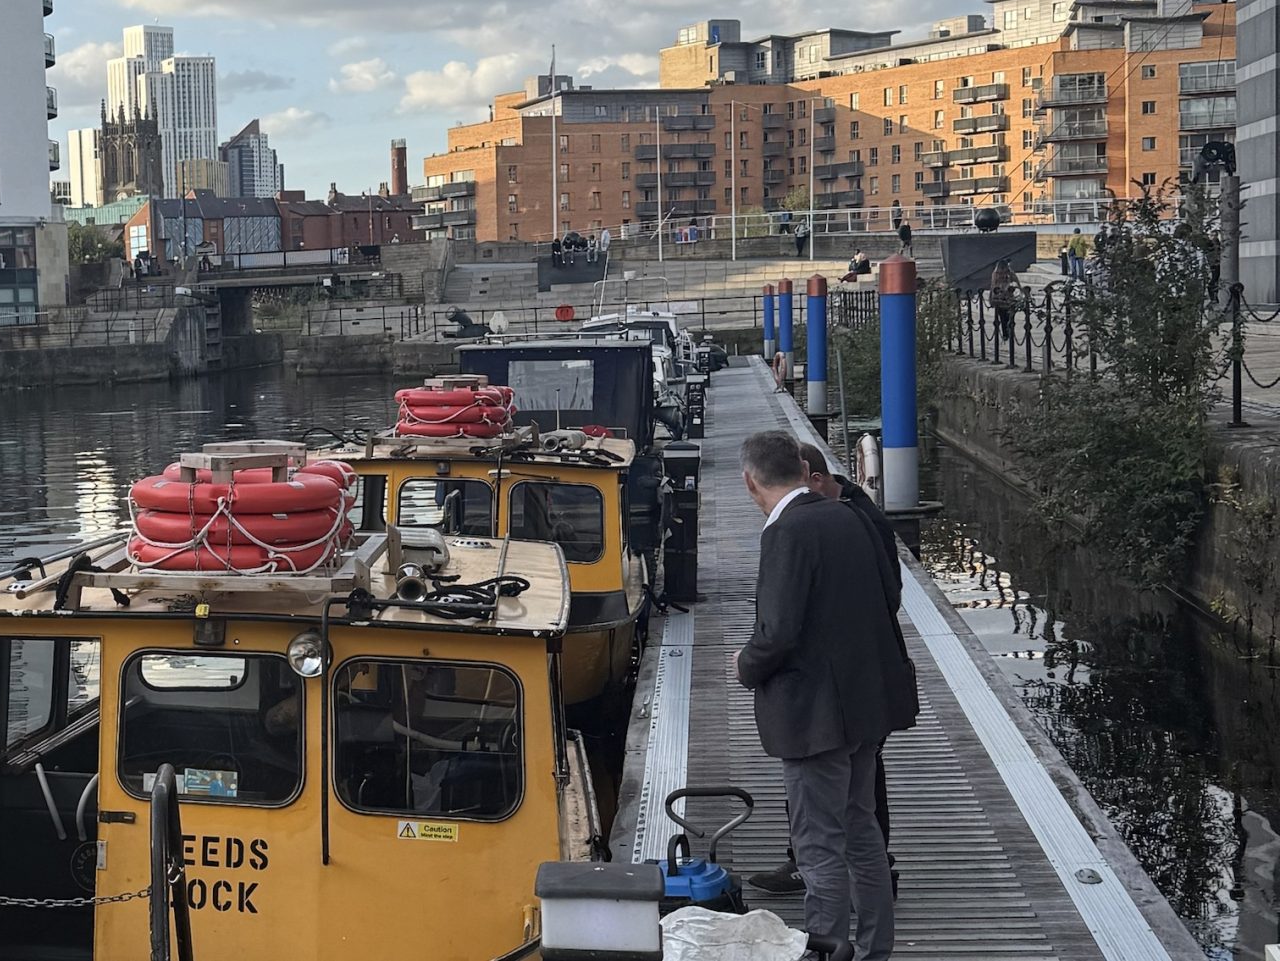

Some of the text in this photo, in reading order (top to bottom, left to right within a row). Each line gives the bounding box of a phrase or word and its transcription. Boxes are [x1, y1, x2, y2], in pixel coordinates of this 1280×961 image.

[424, 824, 452, 833] Caution
[181, 835, 269, 870] EEDS
[187, 879, 259, 913] OCK
